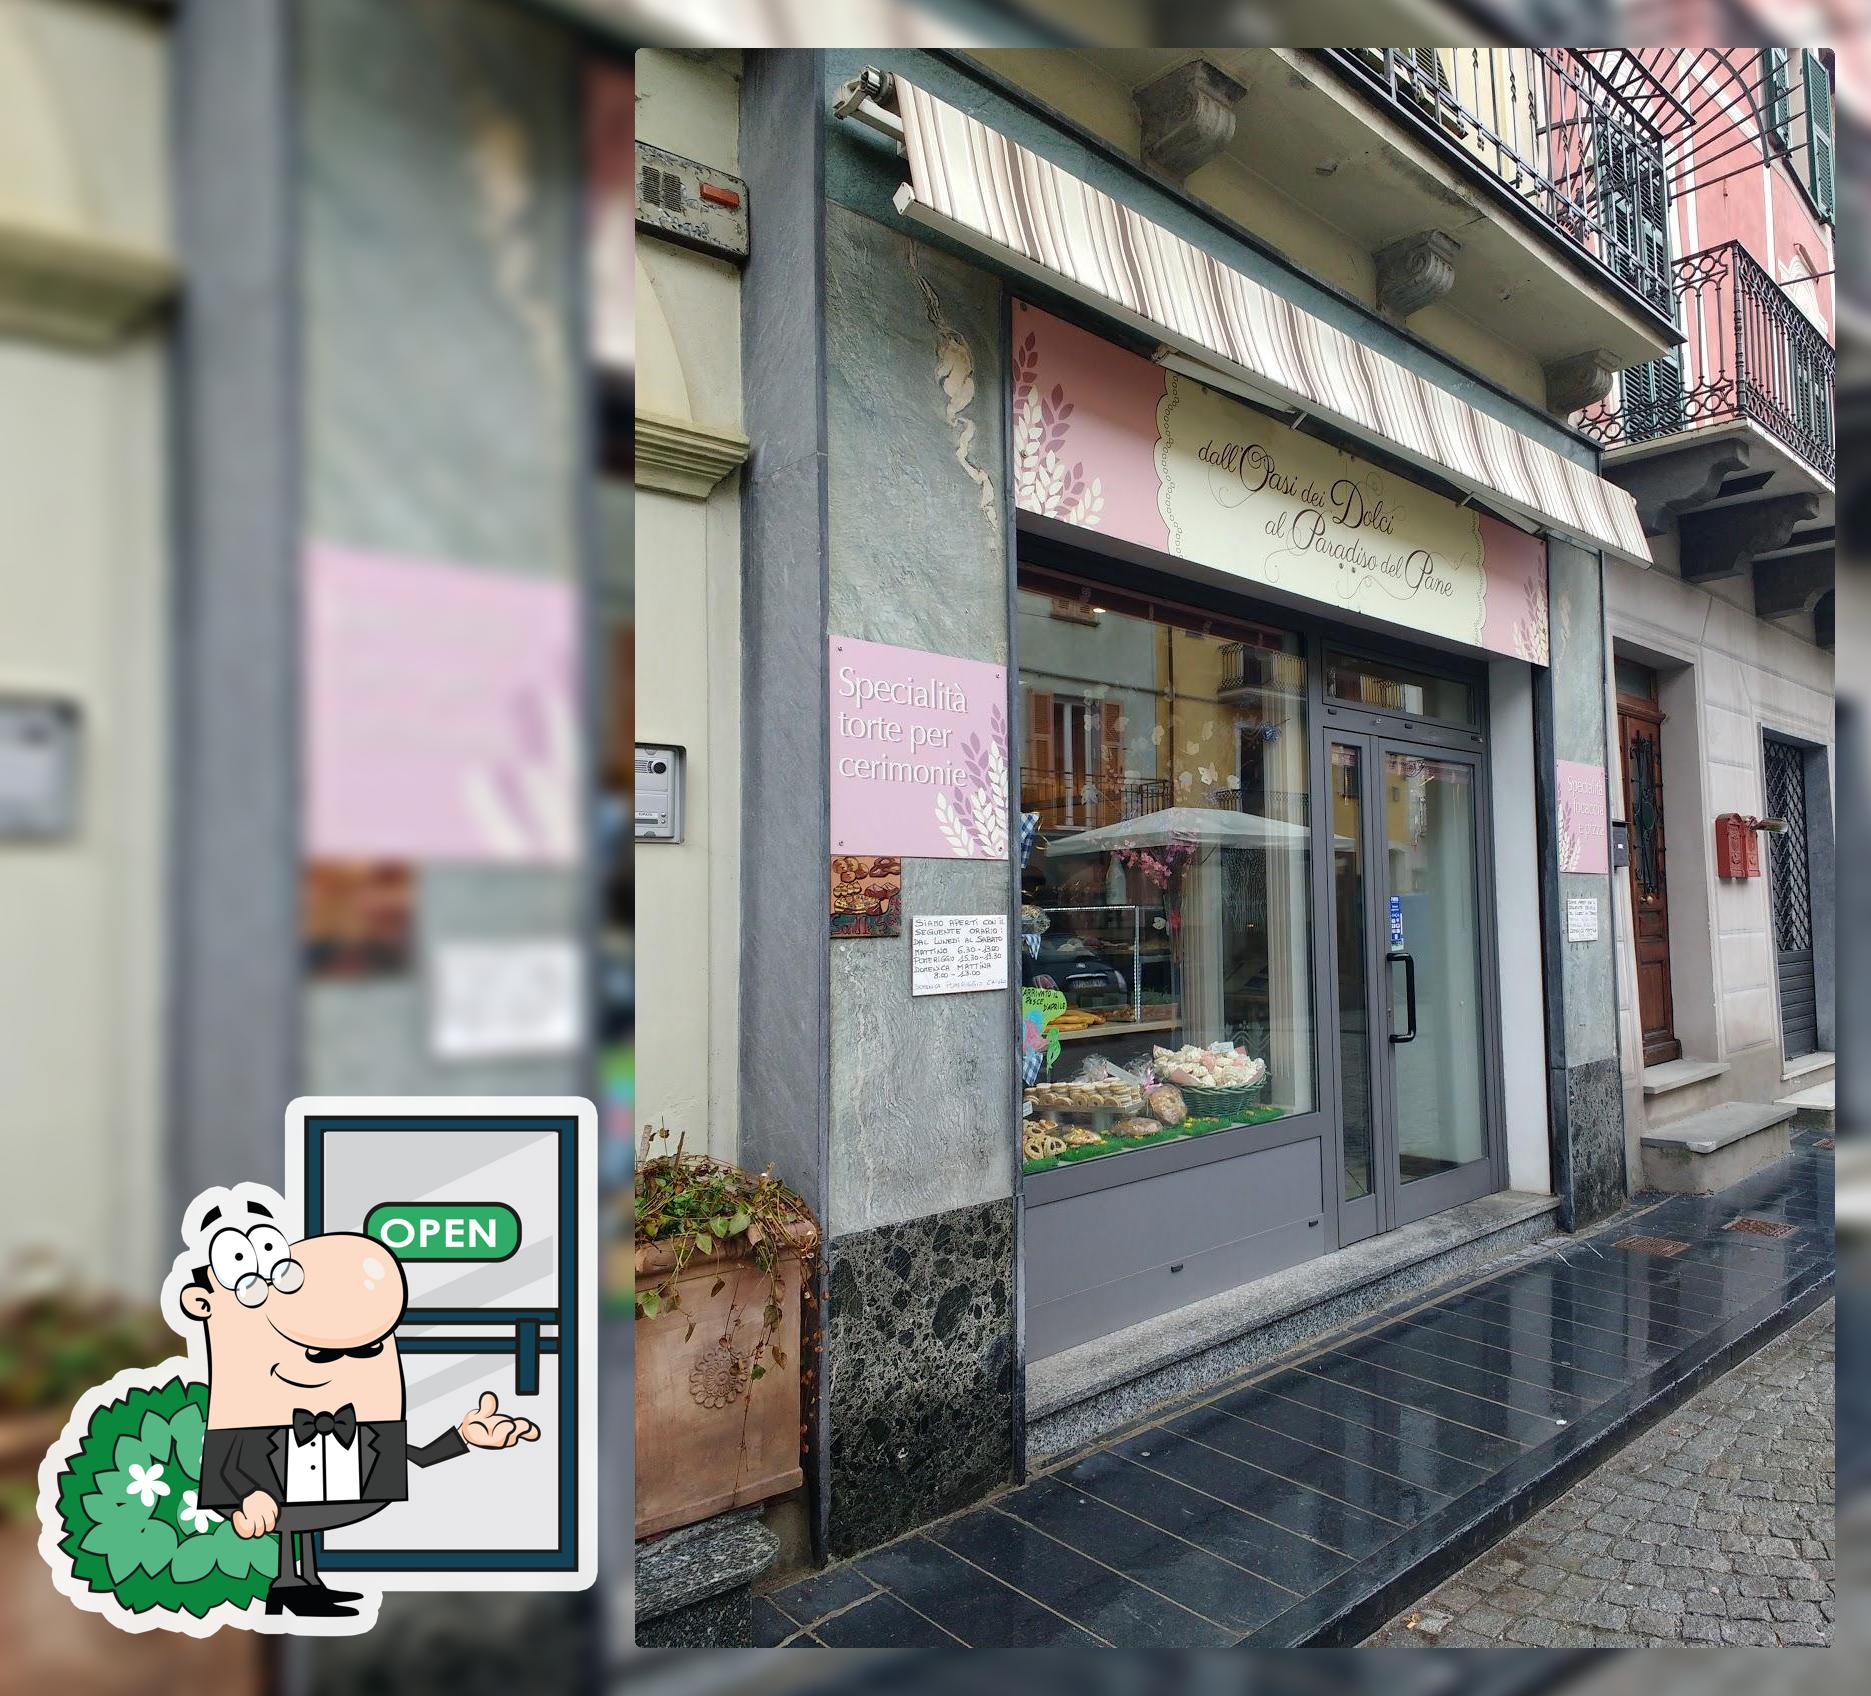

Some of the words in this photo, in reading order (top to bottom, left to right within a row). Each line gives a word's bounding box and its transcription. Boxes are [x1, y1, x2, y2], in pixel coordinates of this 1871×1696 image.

[1301, 481, 1326, 508] dei
[1330, 479, 1395, 535] Dolci
[1264, 511, 1285, 539] al
[1292, 508, 1377, 571] Paradiso
[1380, 555, 1402, 579] del
[1404, 549, 1454, 600] Pane
[839, 666, 969, 714] Specialità
[839, 711, 903, 743] torte
[910, 725, 954, 754] per
[838, 753, 969, 788] cerimonie
